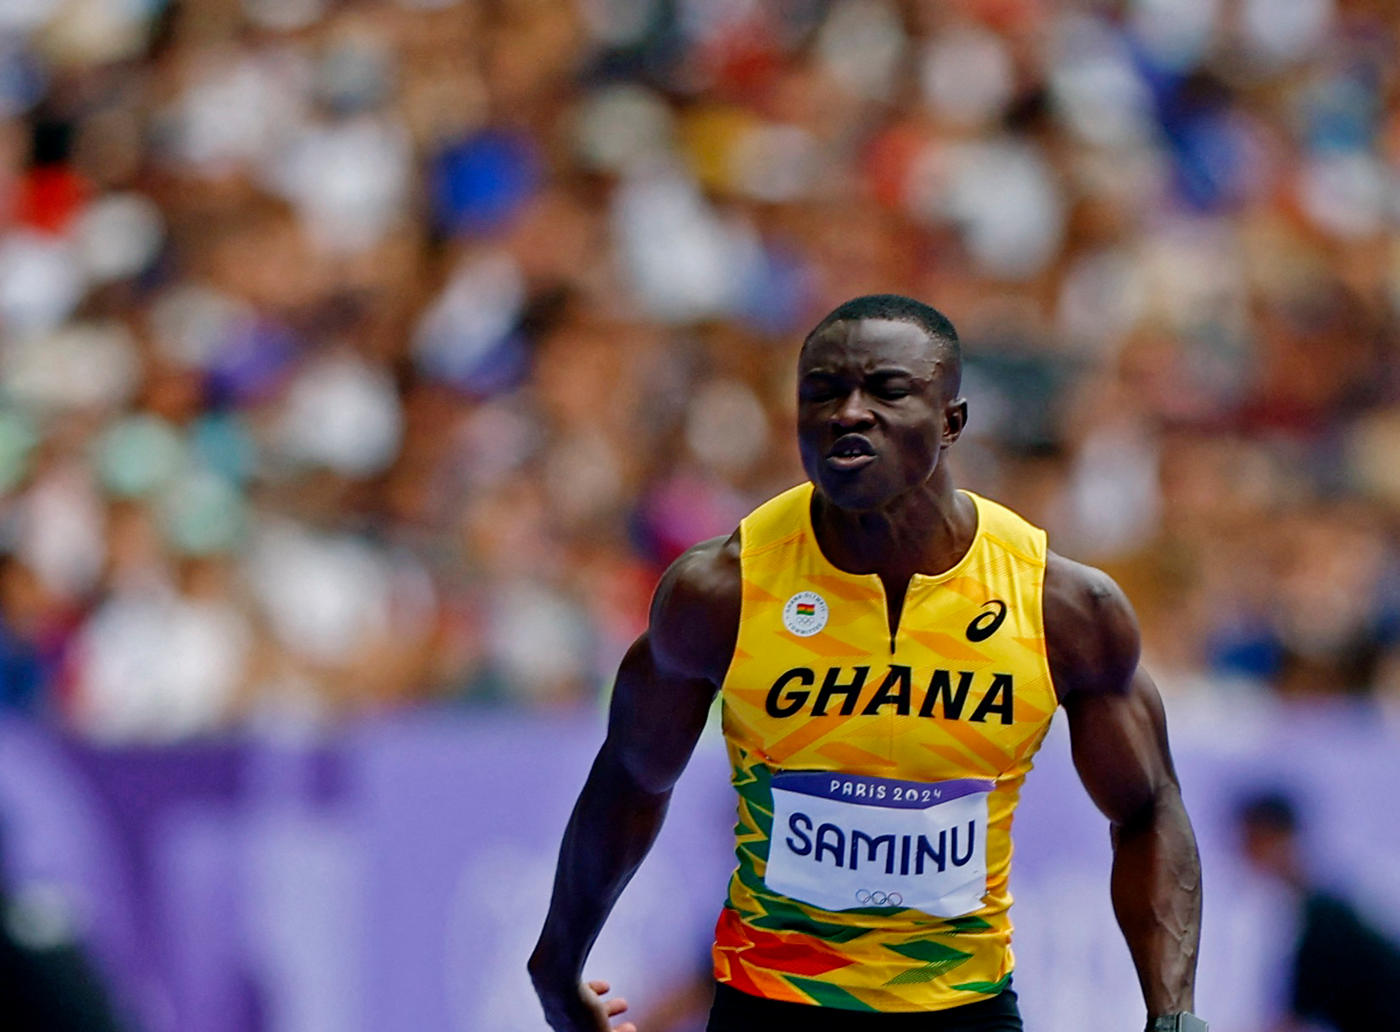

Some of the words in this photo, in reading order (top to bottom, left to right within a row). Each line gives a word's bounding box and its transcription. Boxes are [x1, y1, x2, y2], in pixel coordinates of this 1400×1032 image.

[765, 664, 1015, 725] GHANA
[893, 785, 942, 803] 2024
[785, 812, 976, 876] SAMINU
